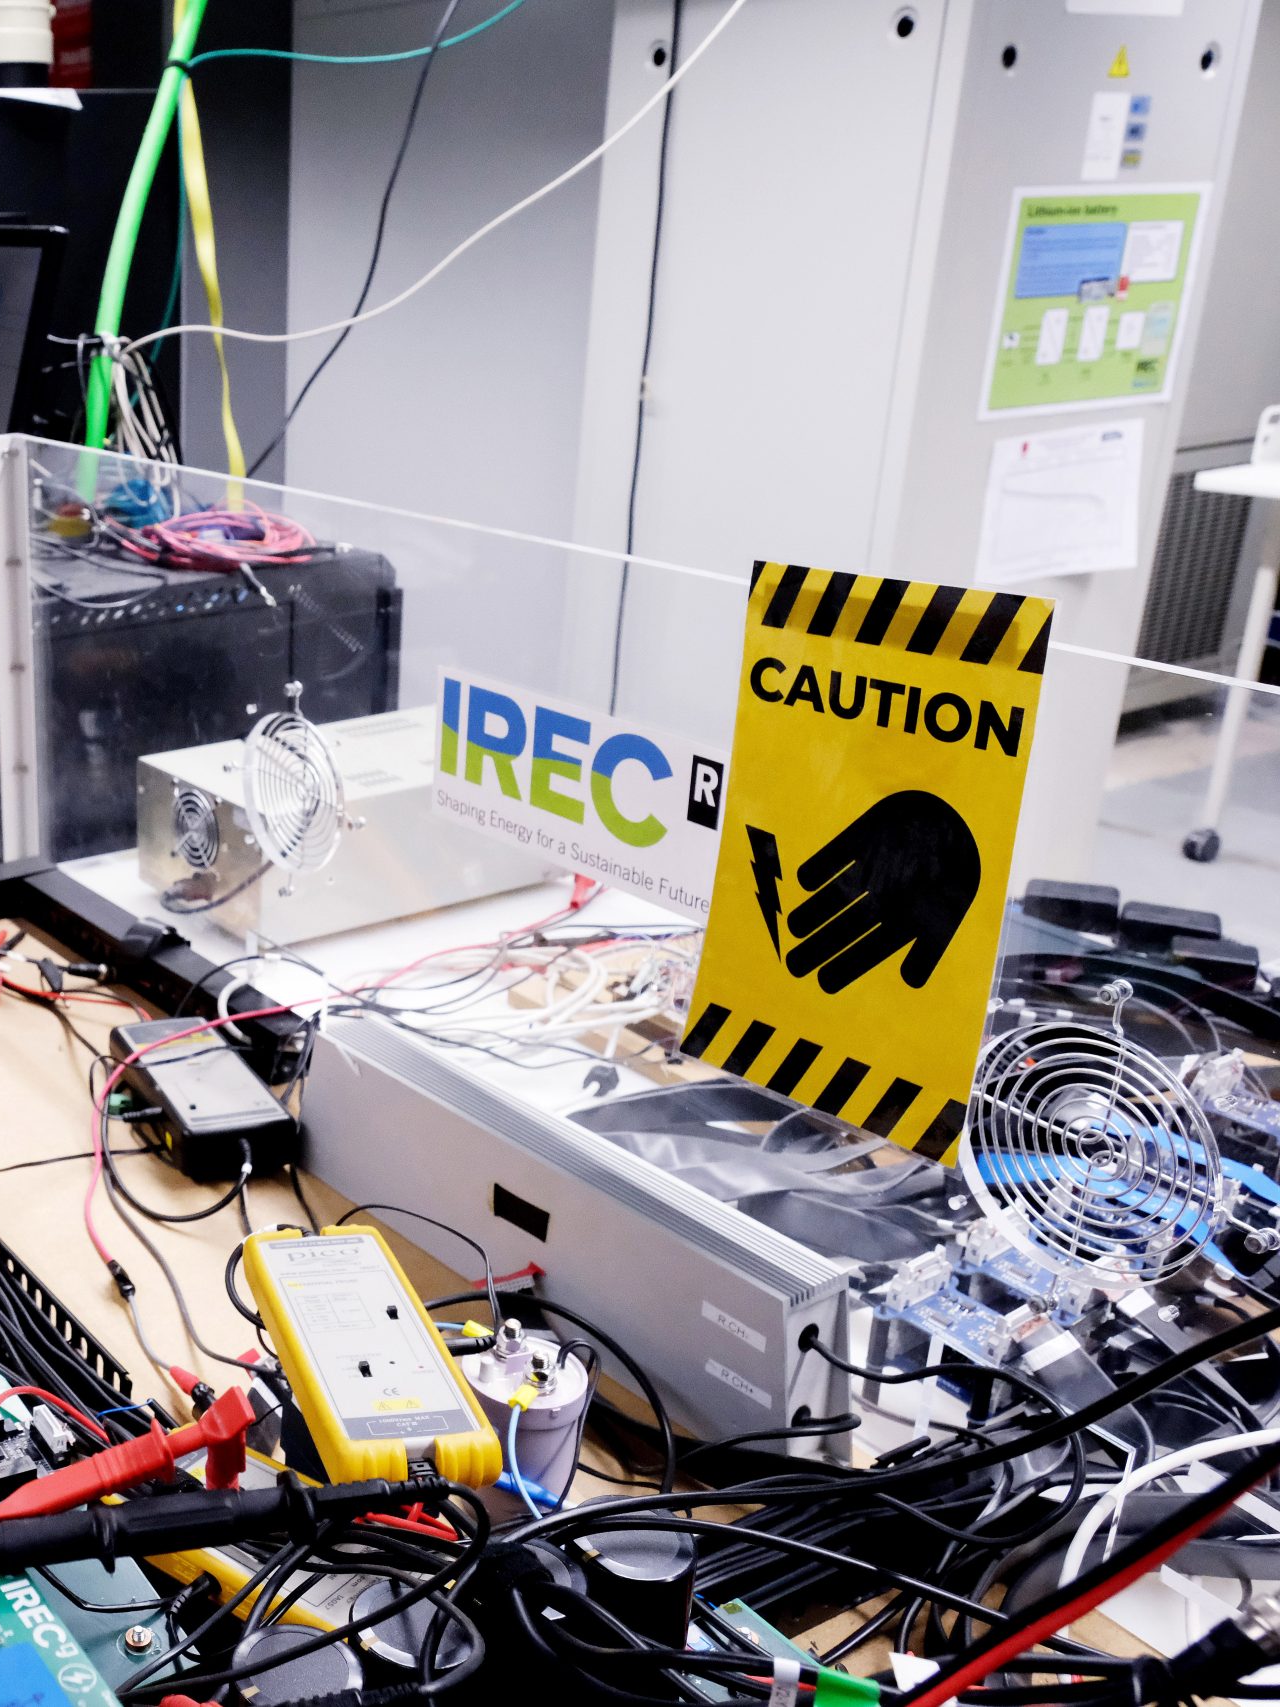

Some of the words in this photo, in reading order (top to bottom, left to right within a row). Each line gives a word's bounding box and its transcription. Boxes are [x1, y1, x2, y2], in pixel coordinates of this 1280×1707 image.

[749, 656, 1025, 759] CAUTION
[439, 676, 674, 849] IREC
[437, 789, 486, 825] Shaping
[489, 810, 533, 844] Energy
[536, 828, 554, 849] for
[557, 842, 566, 855] a
[570, 842, 655, 890] Sustainable
[658, 877, 710, 914] Future
[721, 1368, 729, 1379] R
[0, 1578, 67, 1649] IREC
